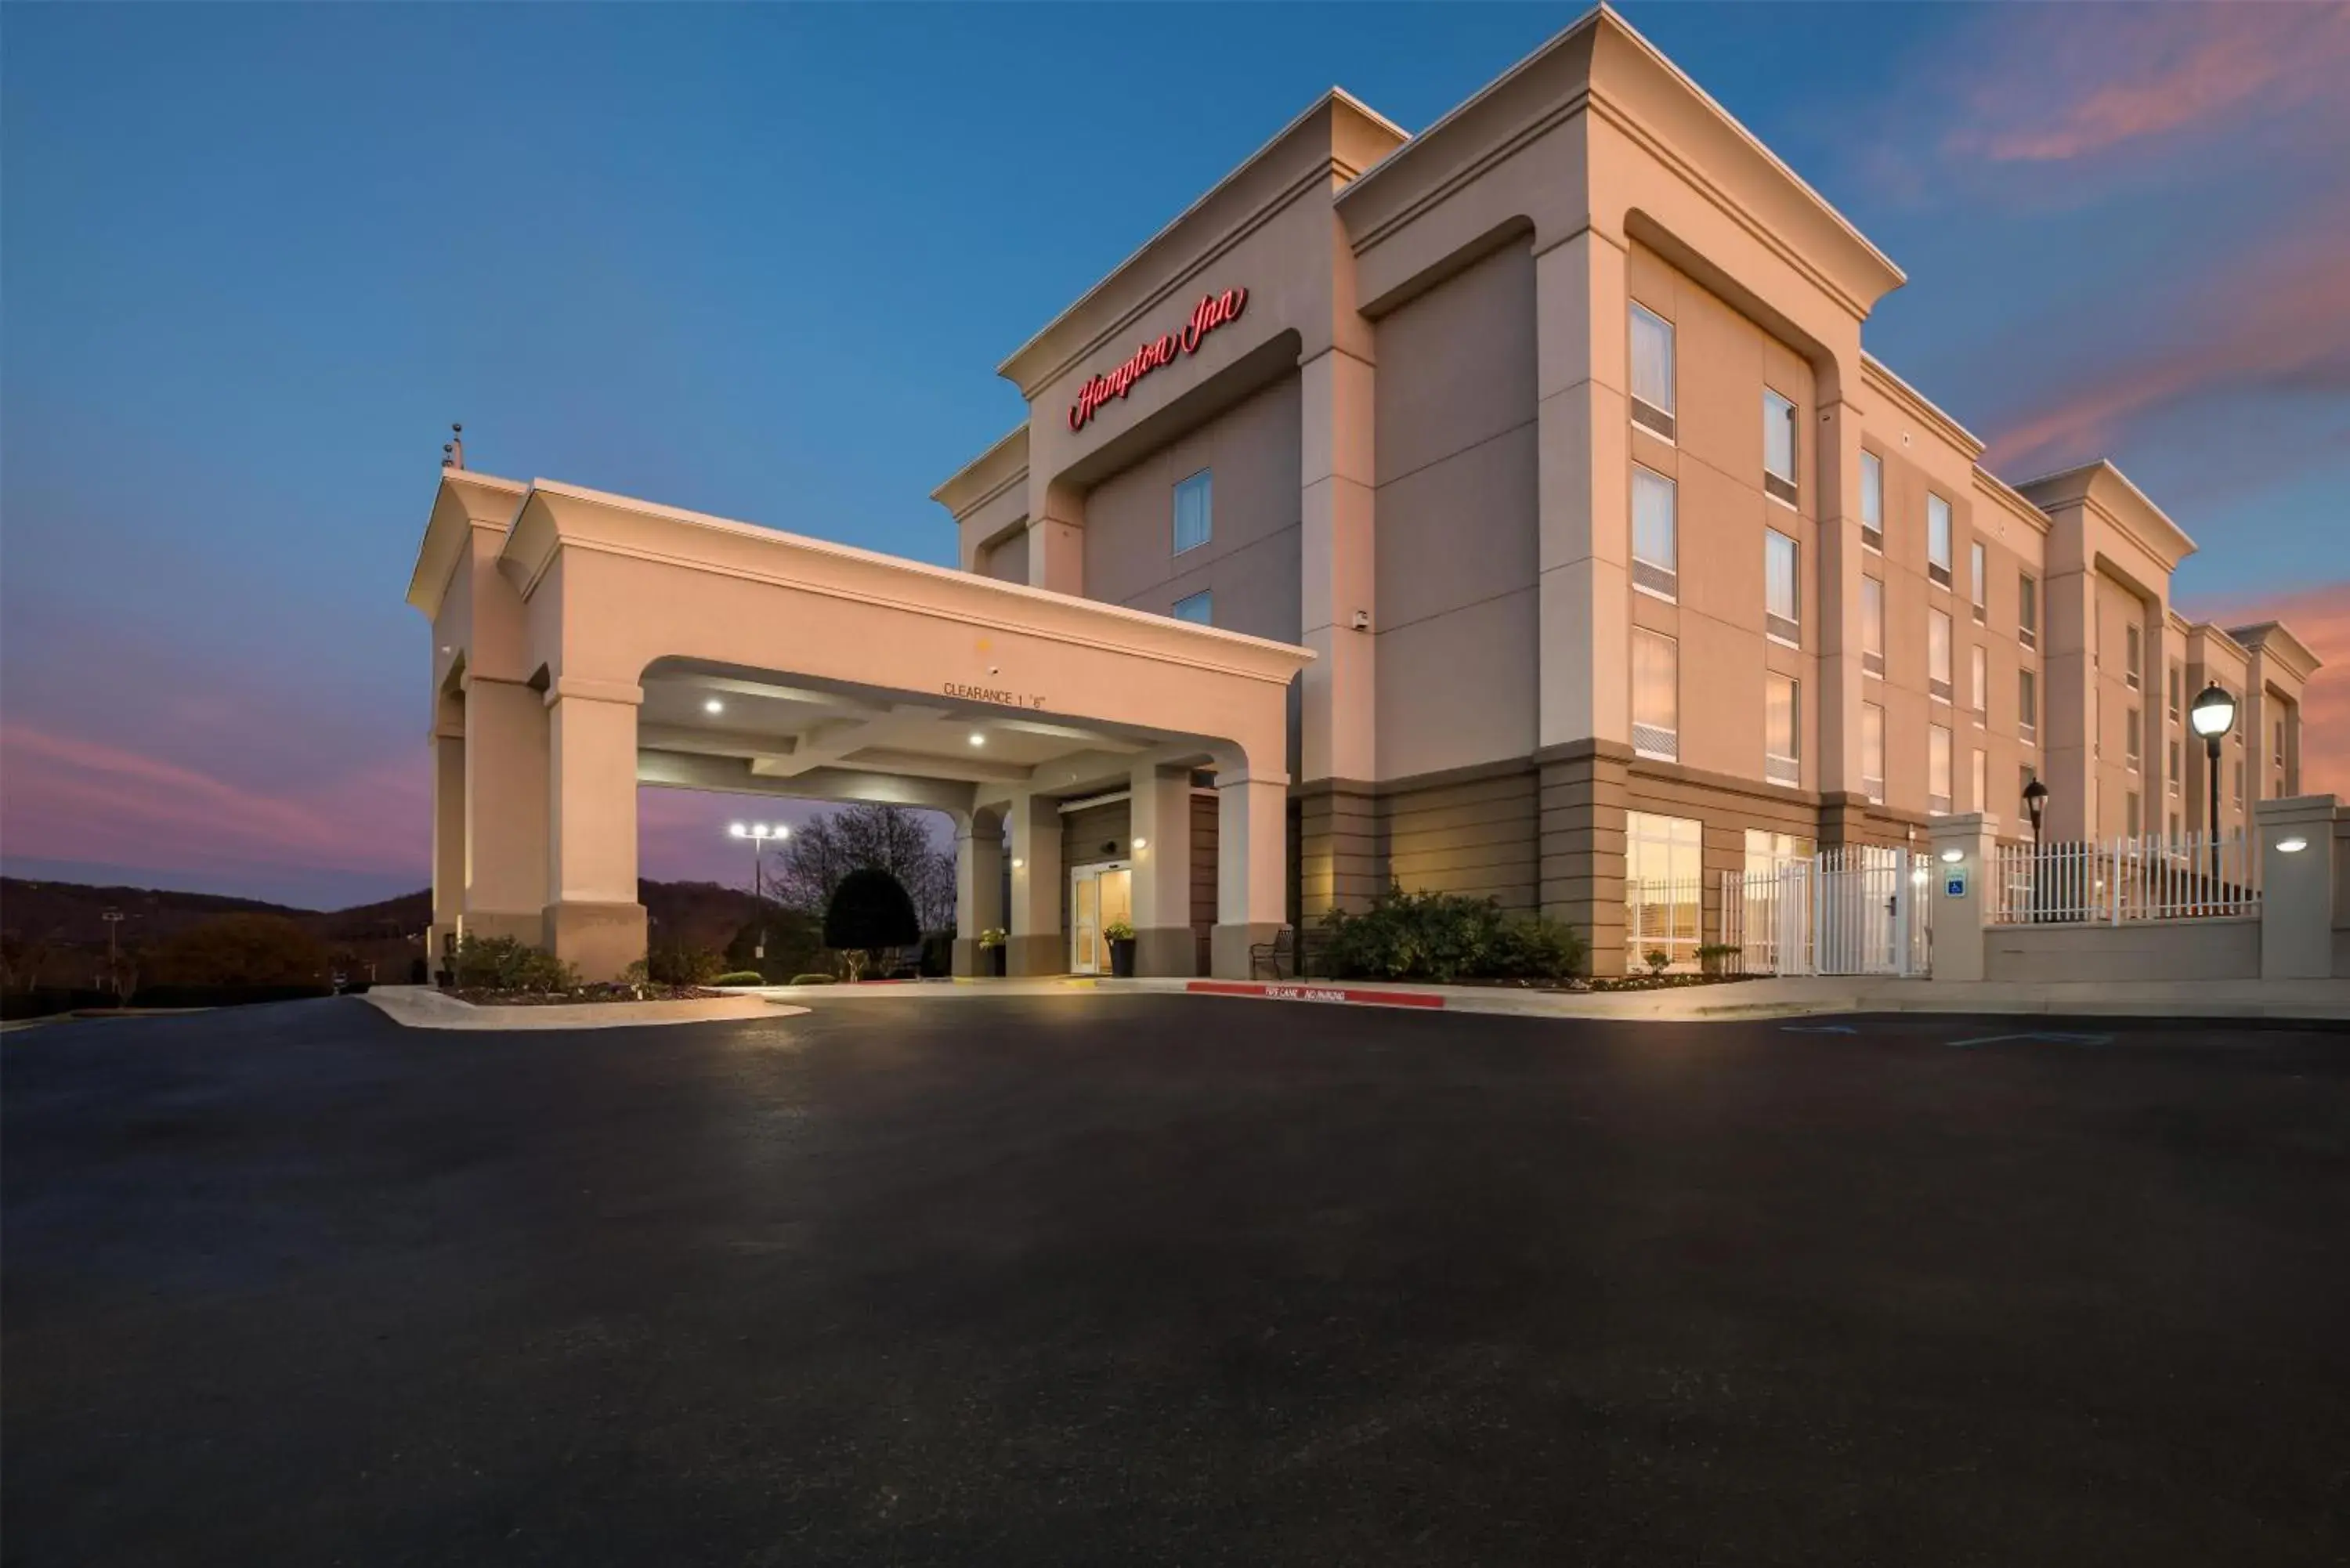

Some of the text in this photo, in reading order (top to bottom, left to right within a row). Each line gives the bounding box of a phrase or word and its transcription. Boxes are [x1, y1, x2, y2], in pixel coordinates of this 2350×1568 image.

[1068, 287, 1249, 432] Hampton Inn
[943, 682, 1013, 704] CLEARANCE
